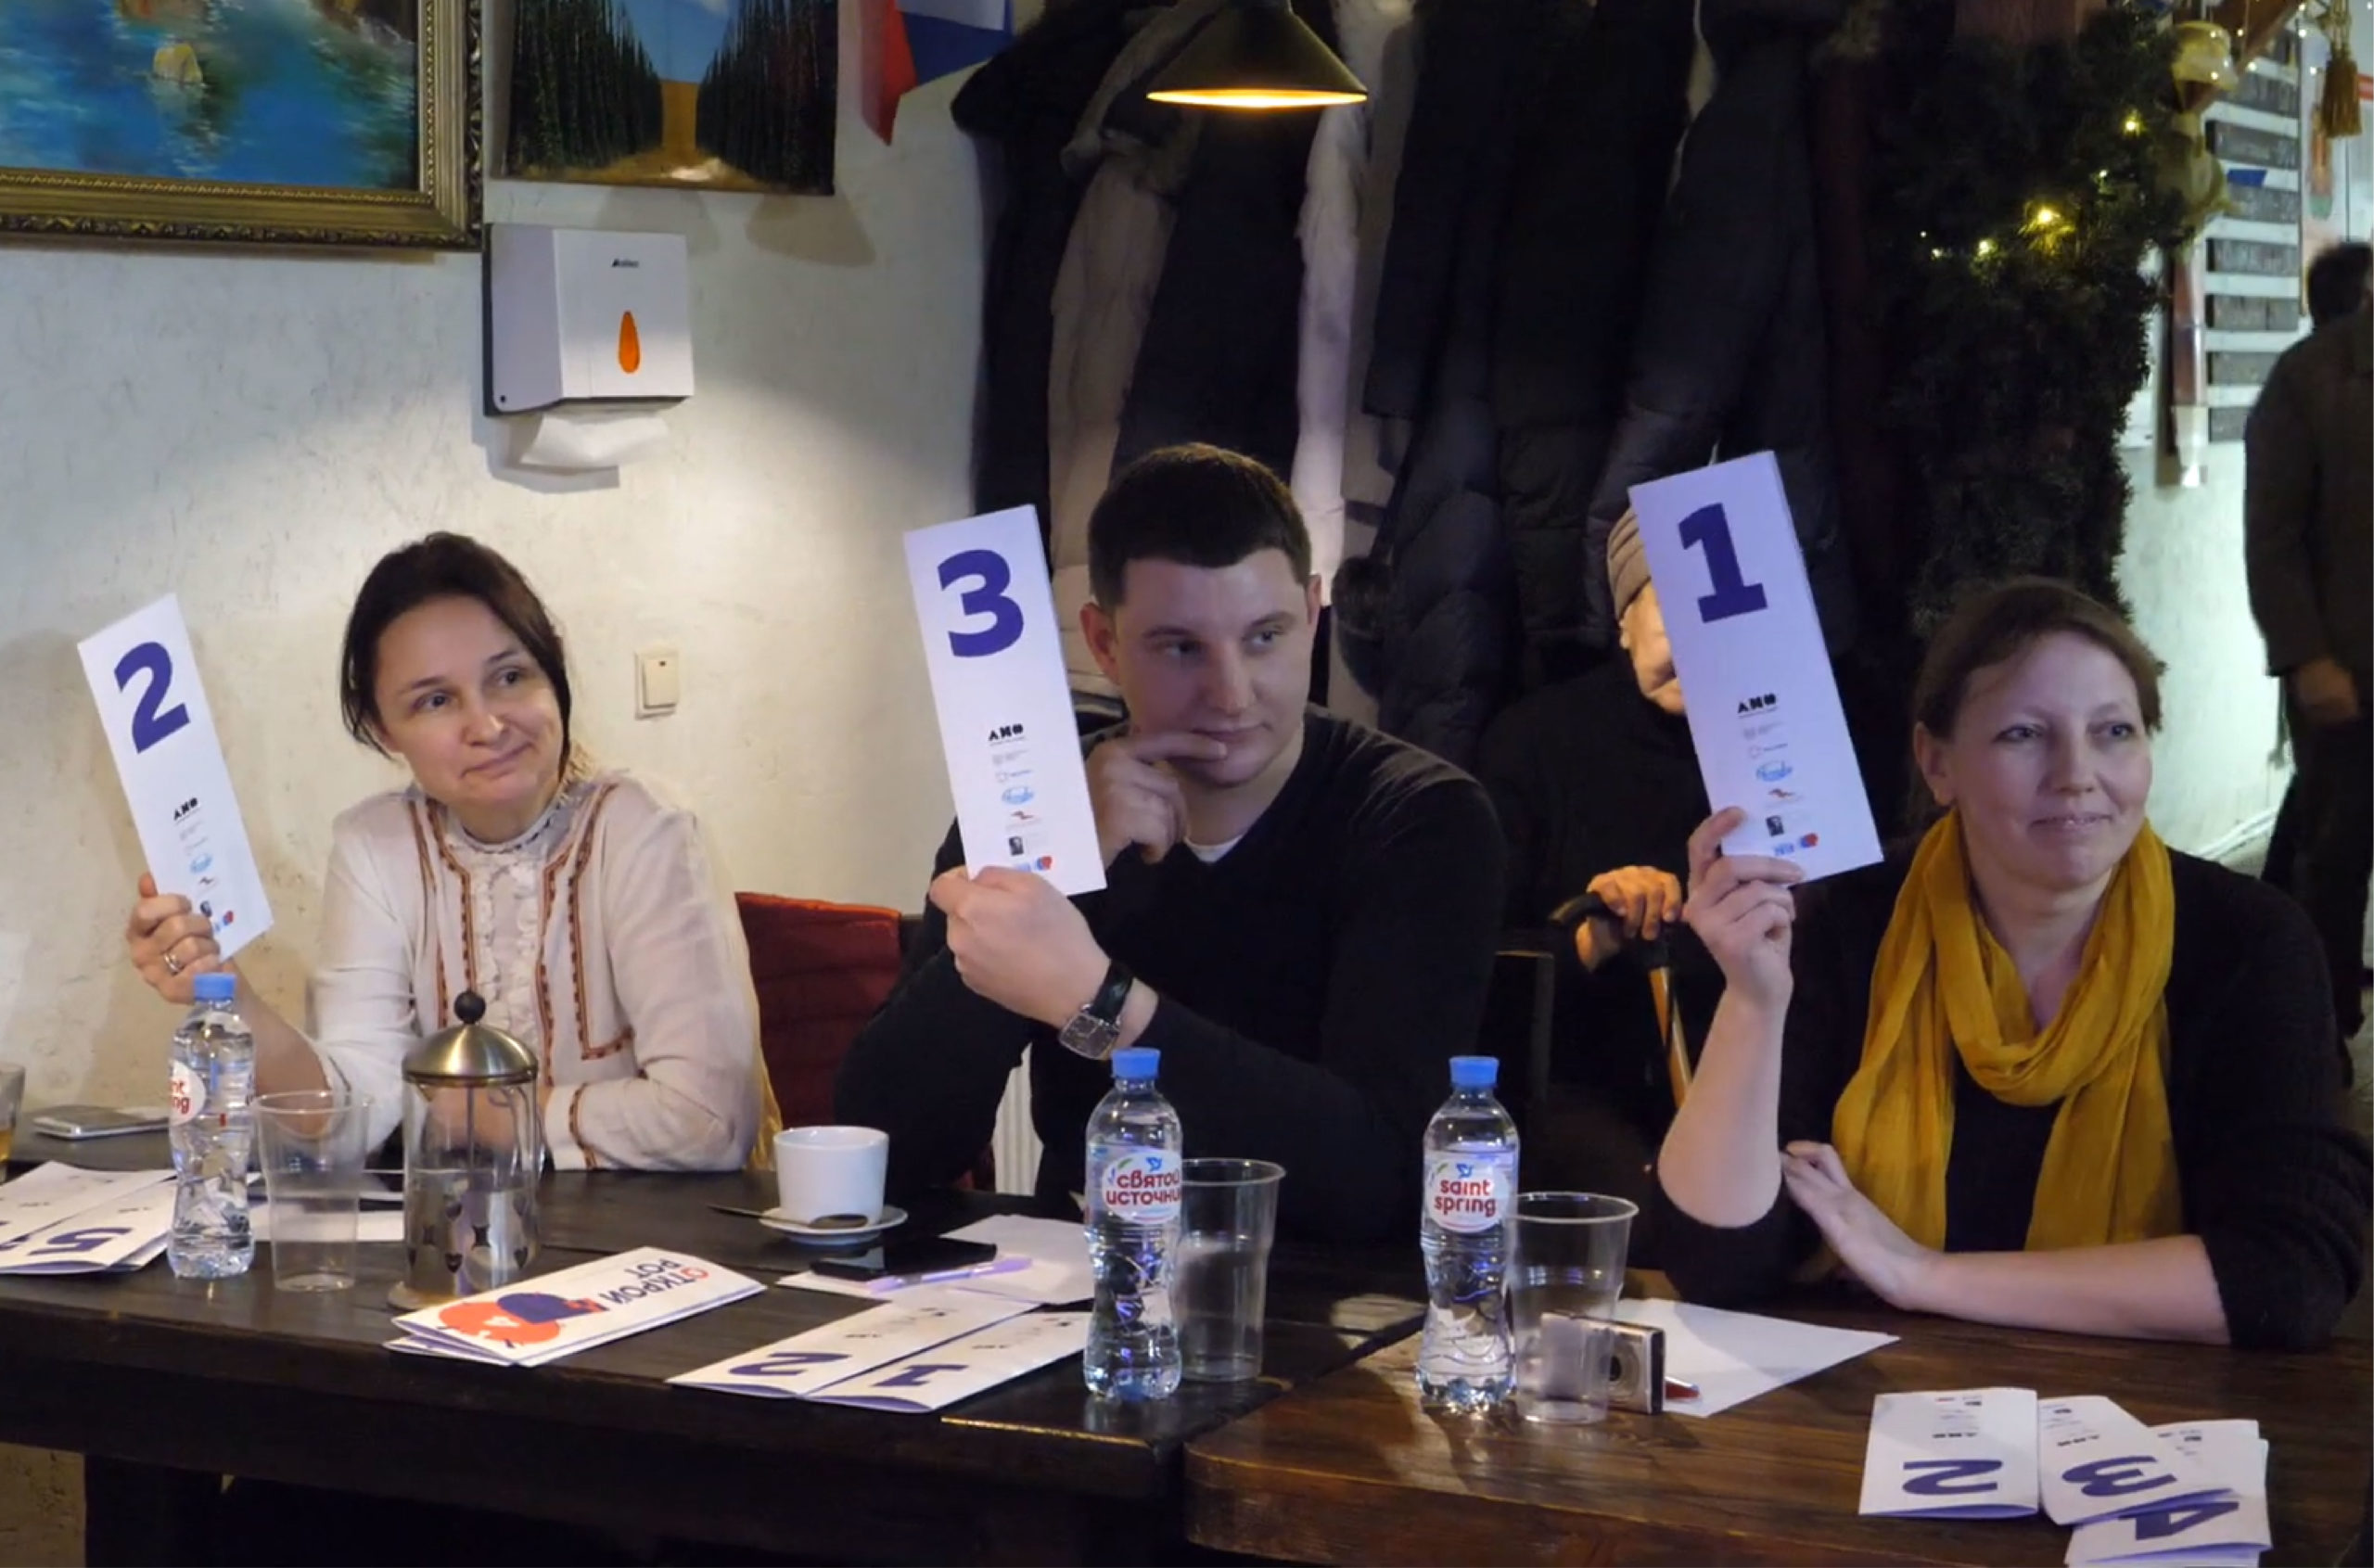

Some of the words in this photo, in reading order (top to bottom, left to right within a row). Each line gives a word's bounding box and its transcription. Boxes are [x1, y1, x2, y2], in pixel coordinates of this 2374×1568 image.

[1678, 502, 1768, 624] 1
[937, 549, 1025, 658] 3
[114, 642, 190, 754] 2
[1440, 1179, 1491, 1196] saint
[1434, 1196, 1497, 1218] spring
[27, 1227, 134, 1256] 5
[624, 1257, 682, 1279] РОТ
[728, 1352, 852, 1377] 2
[870, 1364, 970, 1387] 1
[1902, 1459, 2003, 1496] 2
[2061, 1456, 2177, 1498] 3
[2117, 1500, 2240, 1541] 4
